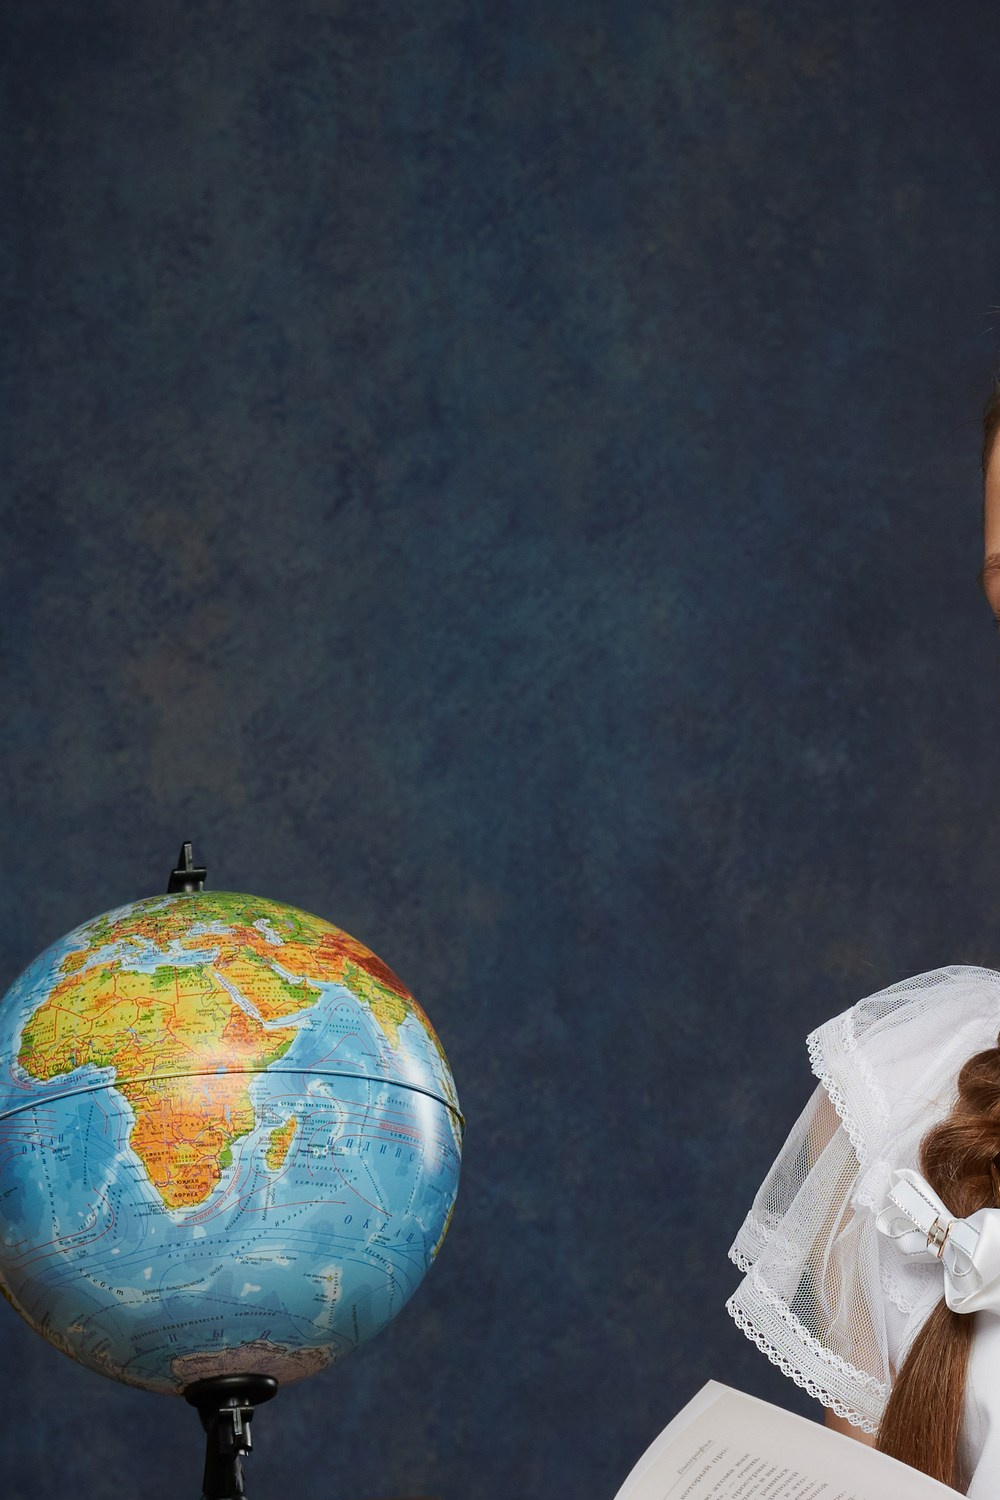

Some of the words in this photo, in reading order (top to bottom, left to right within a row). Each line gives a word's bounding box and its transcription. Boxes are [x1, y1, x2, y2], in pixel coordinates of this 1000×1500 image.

[344, 1214, 413, 1243] ОКЕАН
[79, 1268, 124, 1297] хребет
[679, 1465, 712, 1500] который
[712, 1468, 735, 1492] атома
[734, 1452, 751, 1467] как
[759, 1468, 790, 1497] равных
